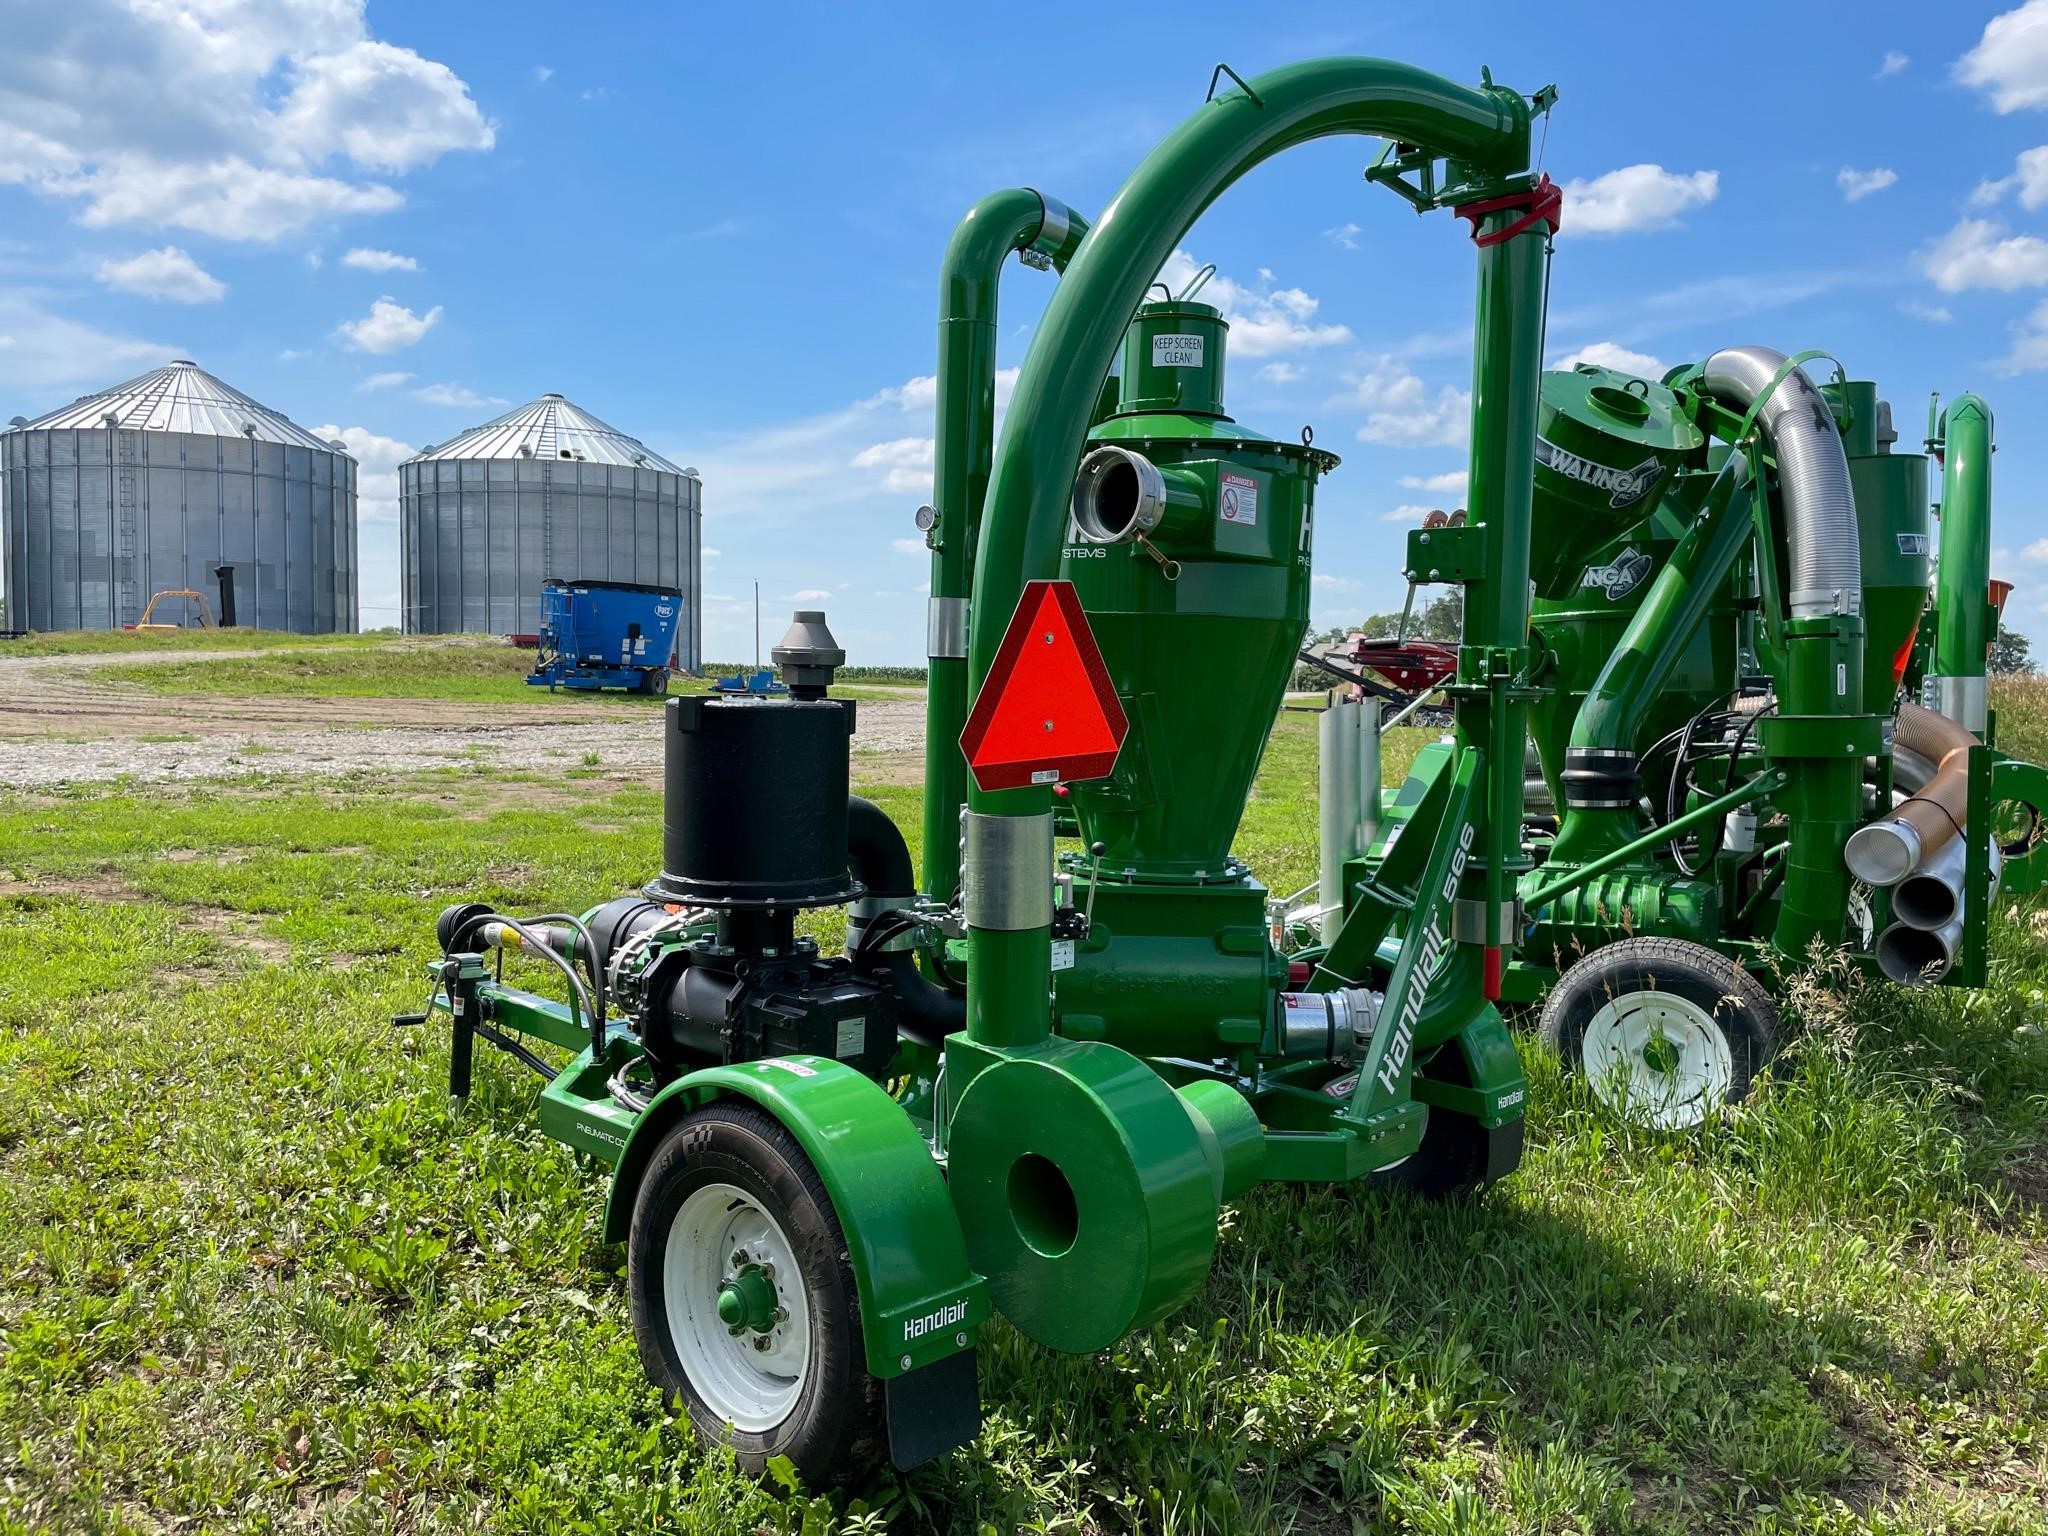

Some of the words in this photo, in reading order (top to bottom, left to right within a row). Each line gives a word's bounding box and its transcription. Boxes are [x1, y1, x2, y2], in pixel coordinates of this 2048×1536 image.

[1154, 337, 1173, 349] KEEP
[1174, 337, 1203, 350] SCREEN
[1164, 351, 1193, 364] CLEAN!
[1231, 475, 1254, 488] DANGER
[1550, 447, 1644, 494] WALINGA
[1062, 548, 1106, 559] STEMS
[1580, 567, 1634, 588] INGA
[1442, 821, 1475, 904] 566
[1377, 911, 1444, 1095] Handlair
[1497, 1088, 1524, 1110] Handlair
[576, 1122, 615, 1144] PNEUMATIC
[904, 1298, 968, 1341] Handlair
